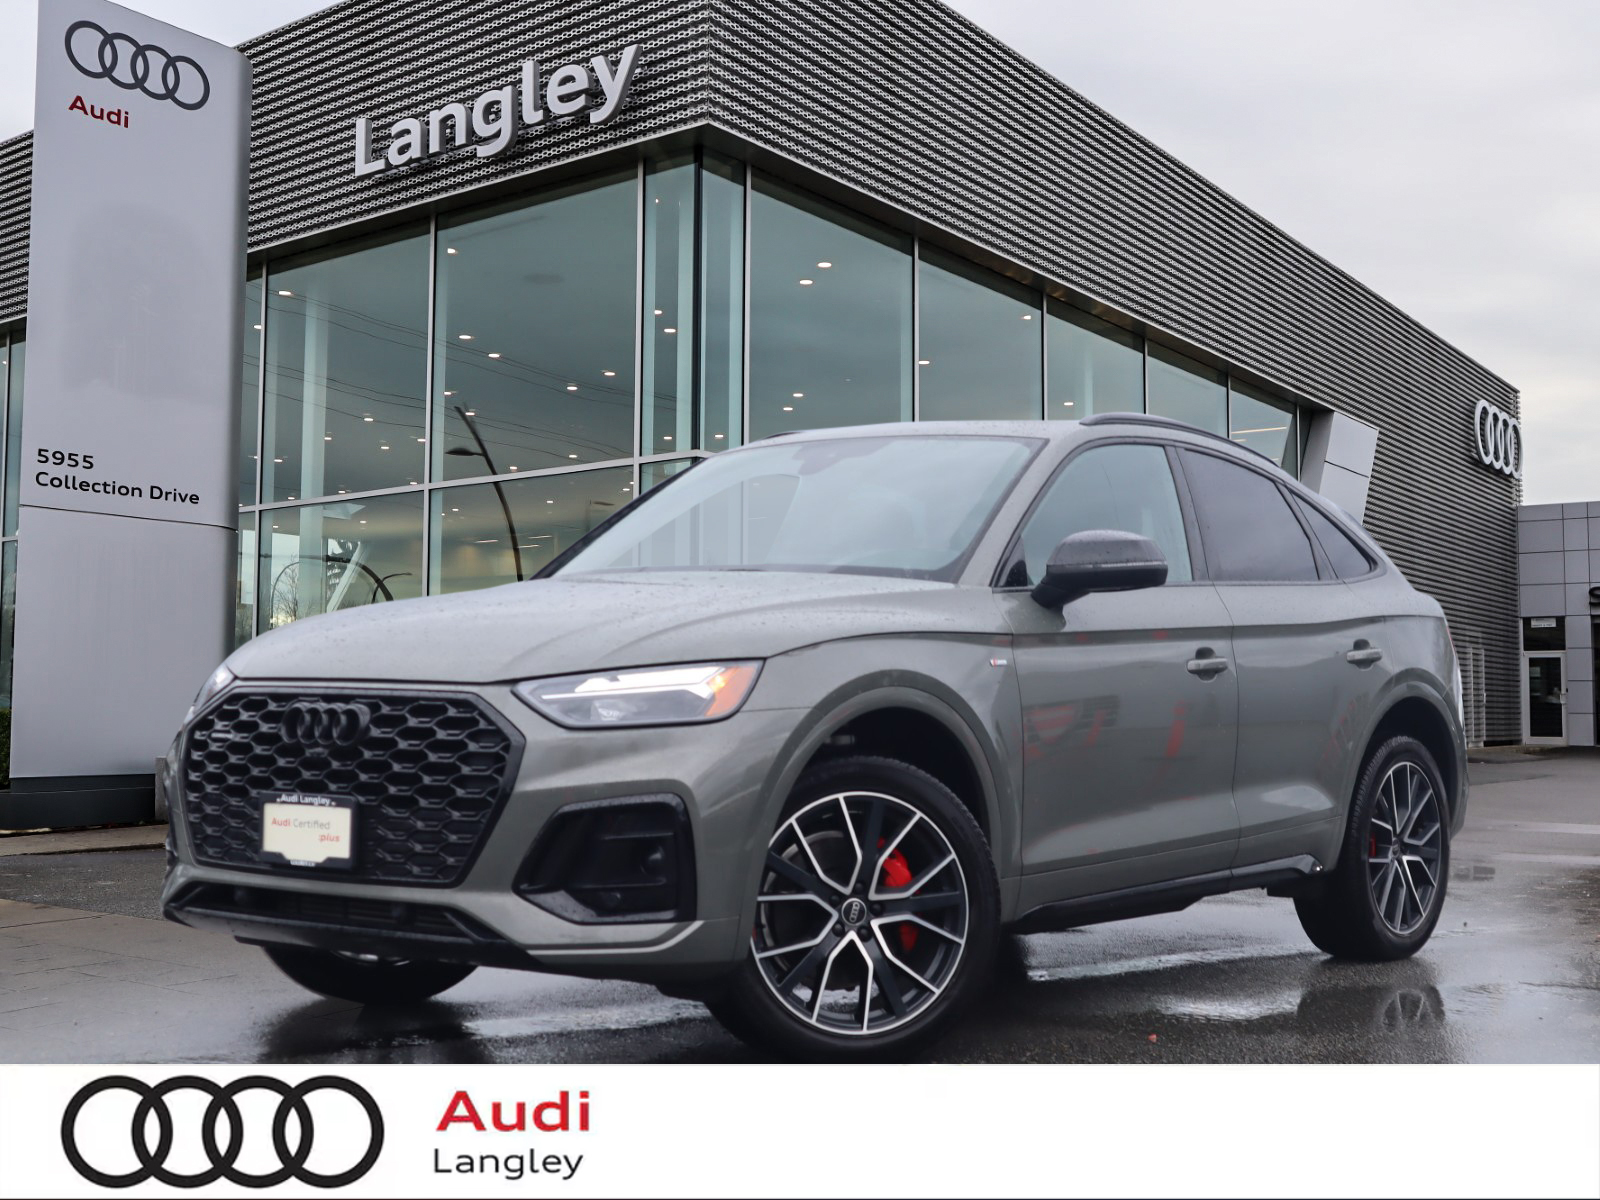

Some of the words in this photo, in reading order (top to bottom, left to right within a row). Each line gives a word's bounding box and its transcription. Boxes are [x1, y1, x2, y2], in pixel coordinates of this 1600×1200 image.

[69, 95, 129, 128] Audi
[354, 44, 643, 177] Langley
[37, 448, 94, 469] 5955
[35, 471, 143, 498] Collection
[150, 485, 200, 504] Drive
[280, 793, 298, 802] Audi
[300, 795, 331, 806] Langley
[271, 817, 291, 827] Audi
[293, 818, 331, 830] Certified
